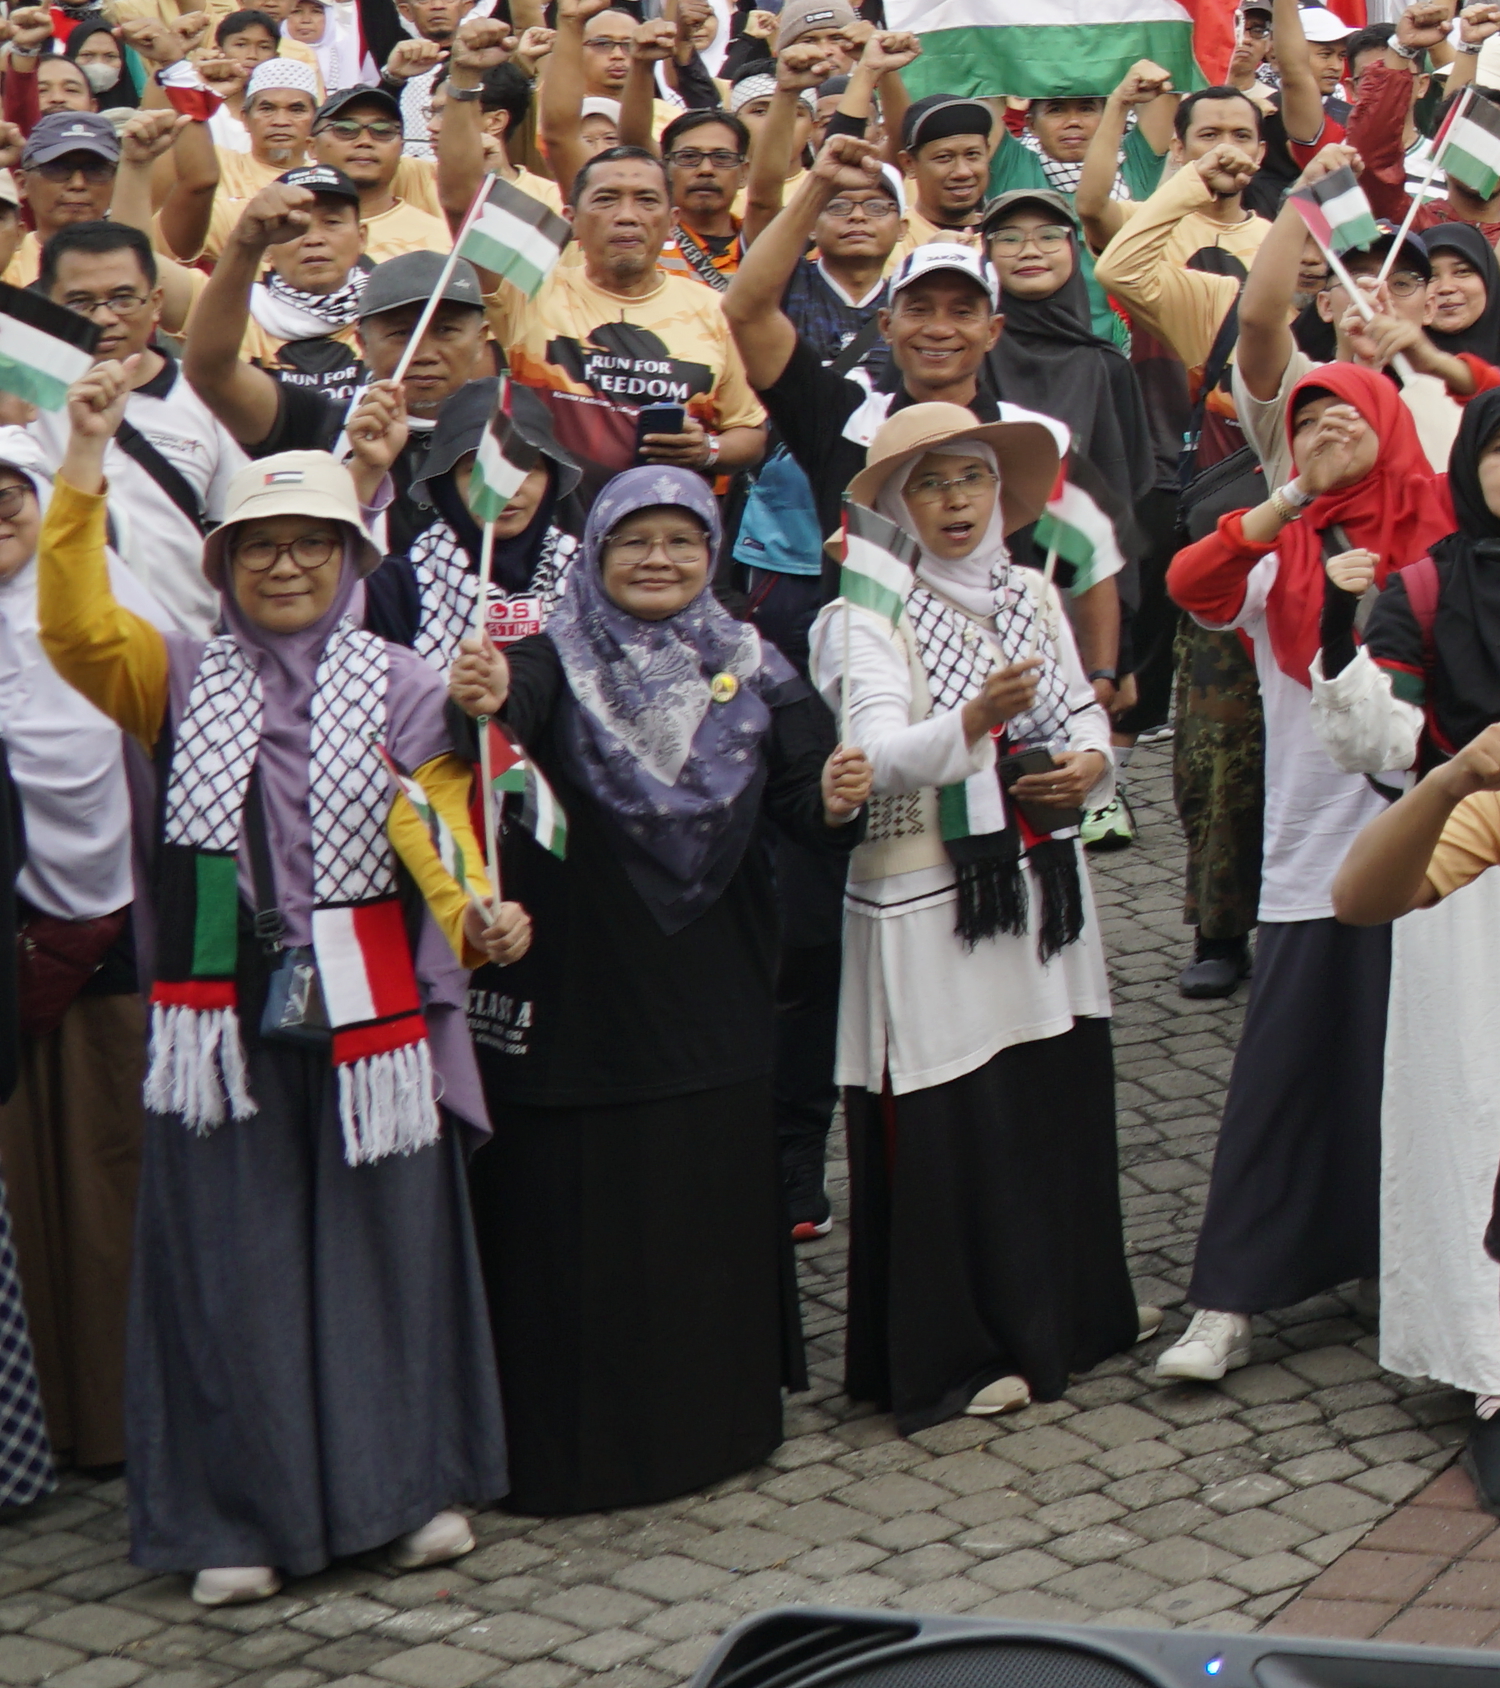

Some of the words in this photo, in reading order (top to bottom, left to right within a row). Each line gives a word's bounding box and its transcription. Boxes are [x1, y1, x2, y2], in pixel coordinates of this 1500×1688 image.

[591, 354, 630, 370] RUN
[634, 359, 672, 374] FOR
[281, 371, 319, 386] RUN
[323, 366, 357, 385] FOR
[515, 1001, 533, 1028] A
